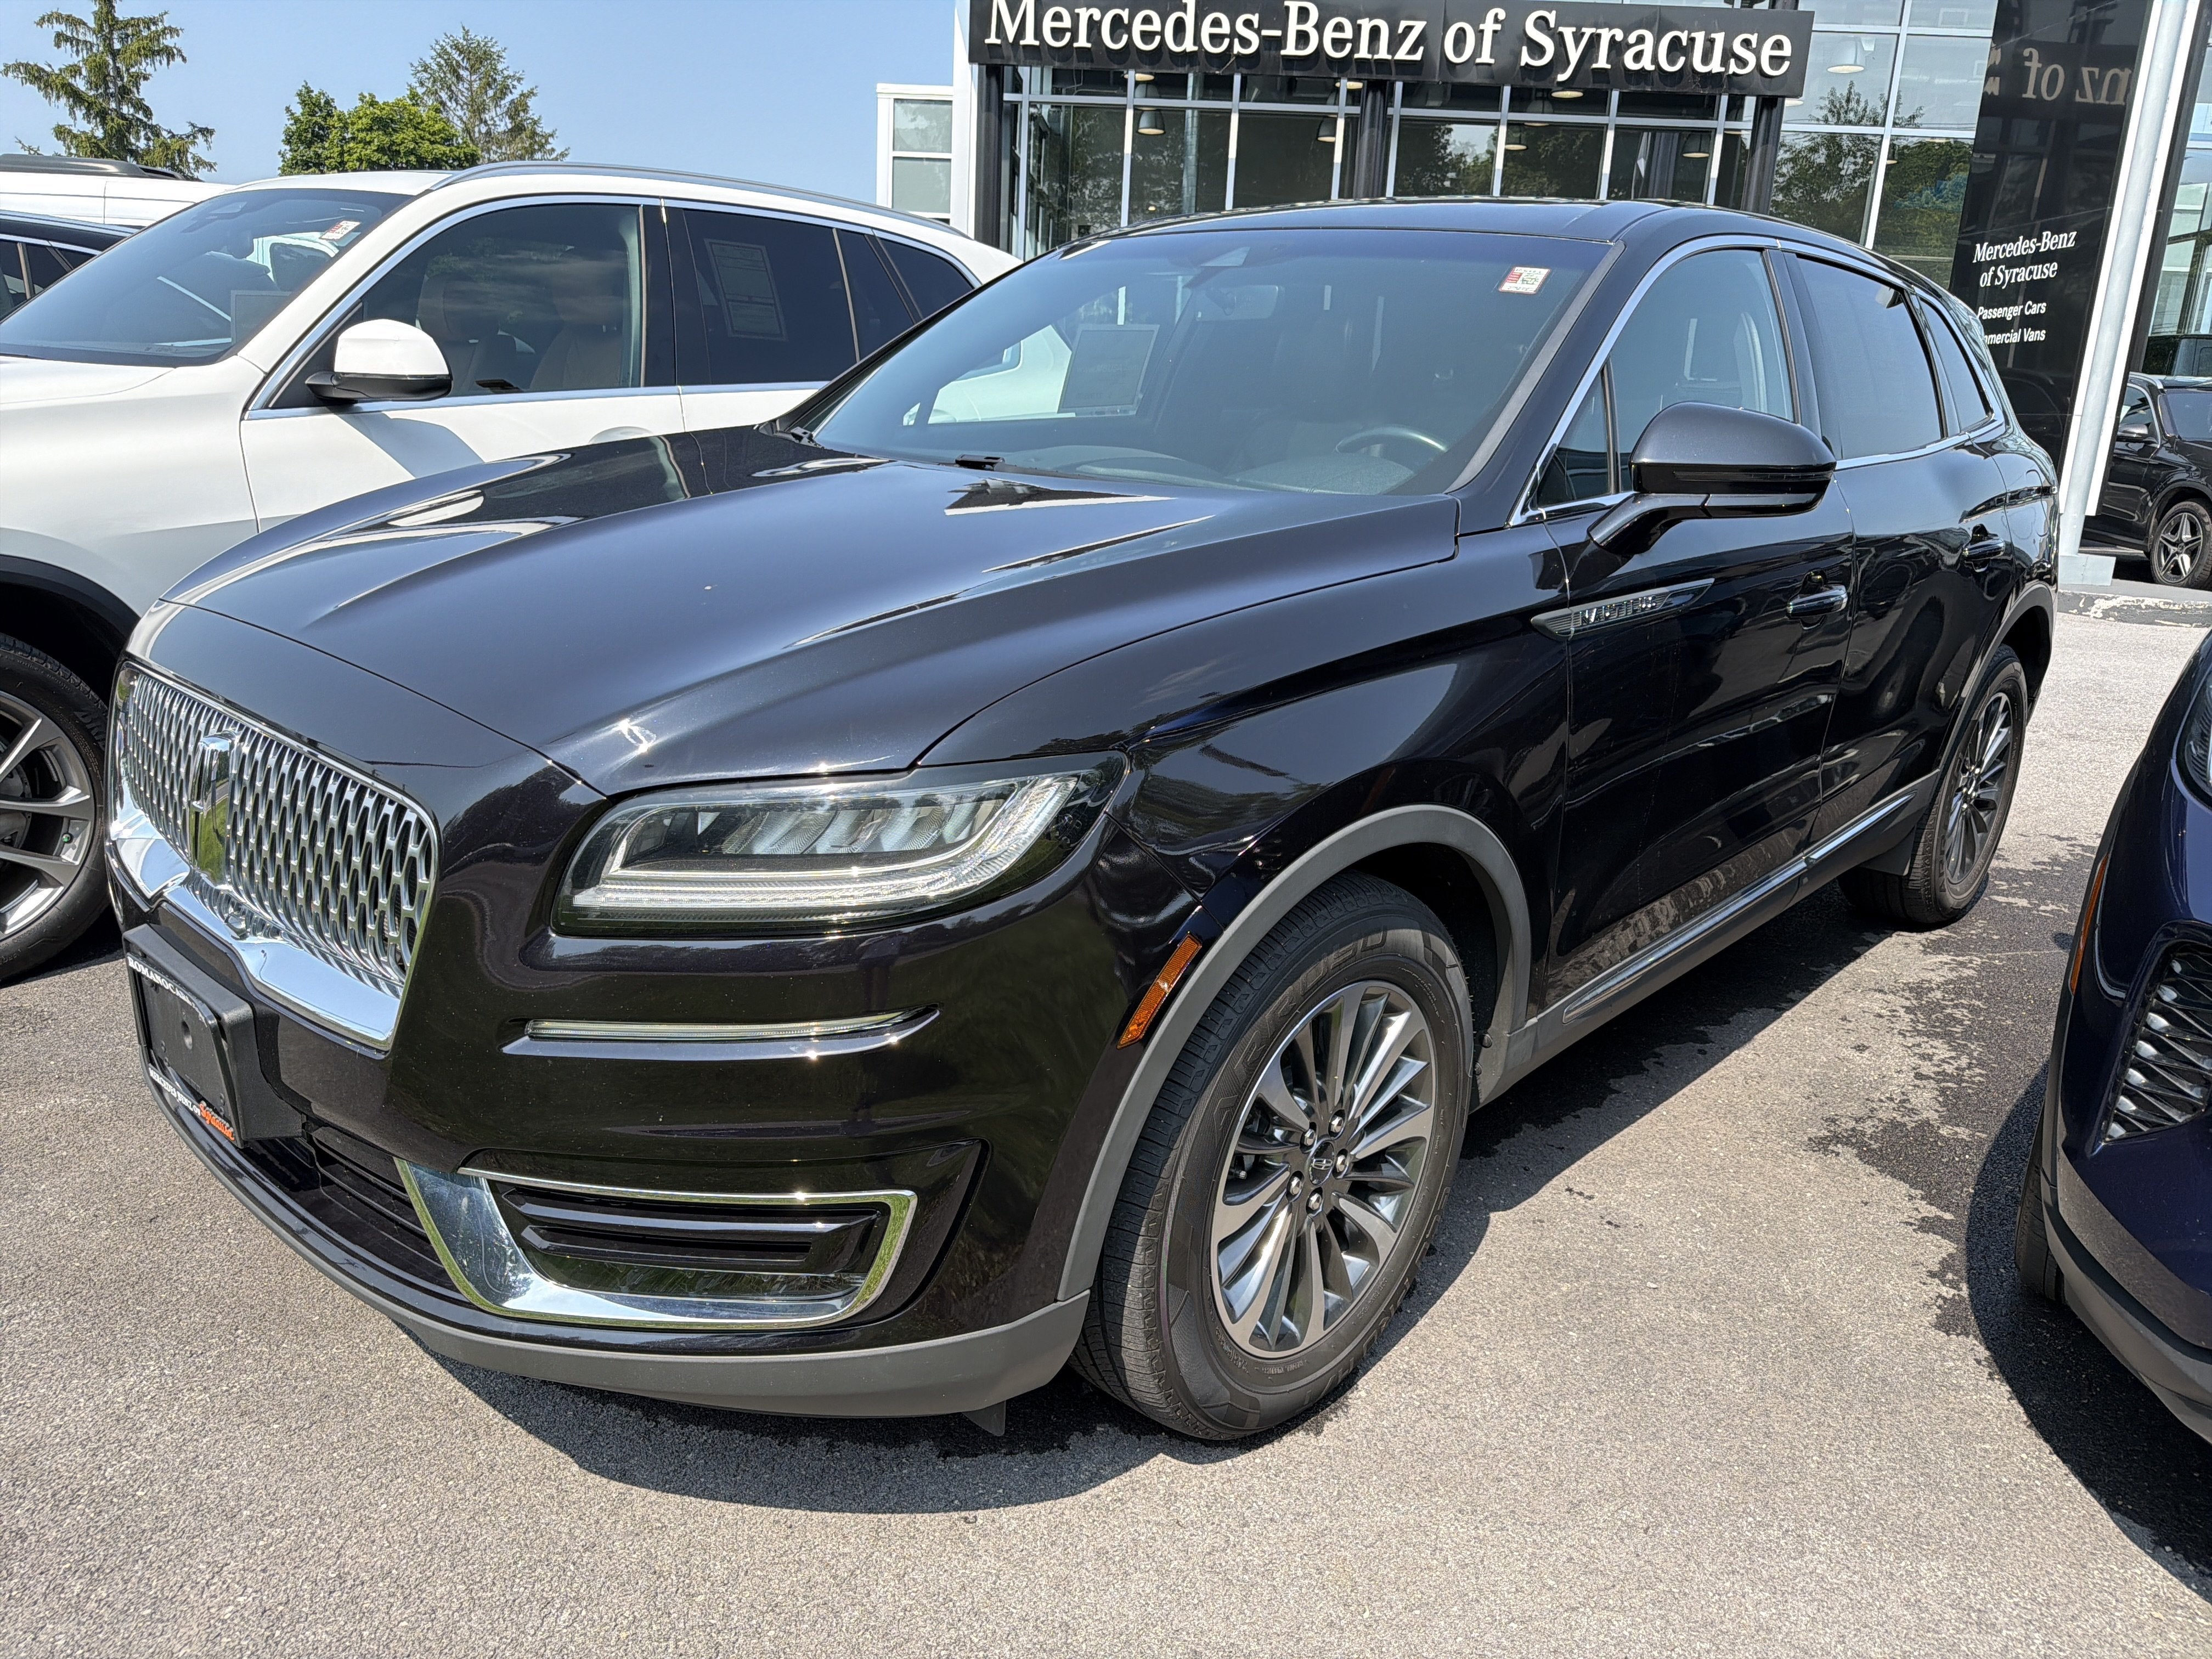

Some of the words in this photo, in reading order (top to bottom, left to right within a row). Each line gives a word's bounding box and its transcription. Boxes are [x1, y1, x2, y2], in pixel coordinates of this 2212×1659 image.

[984, 0, 1427, 61] Mercedes-Benz
[1444, 8, 1506, 65] of
[1520, 10, 1793, 82] Syracuse
[1972, 230, 2078, 263] Mercedes-Benz
[1979, 266, 1995, 287] of
[1995, 262, 2058, 289] Syracuse
[1977, 305, 2024, 320] Passenger
[2024, 300, 2047, 315] Cars
[2024, 328, 2046, 342] Vans
